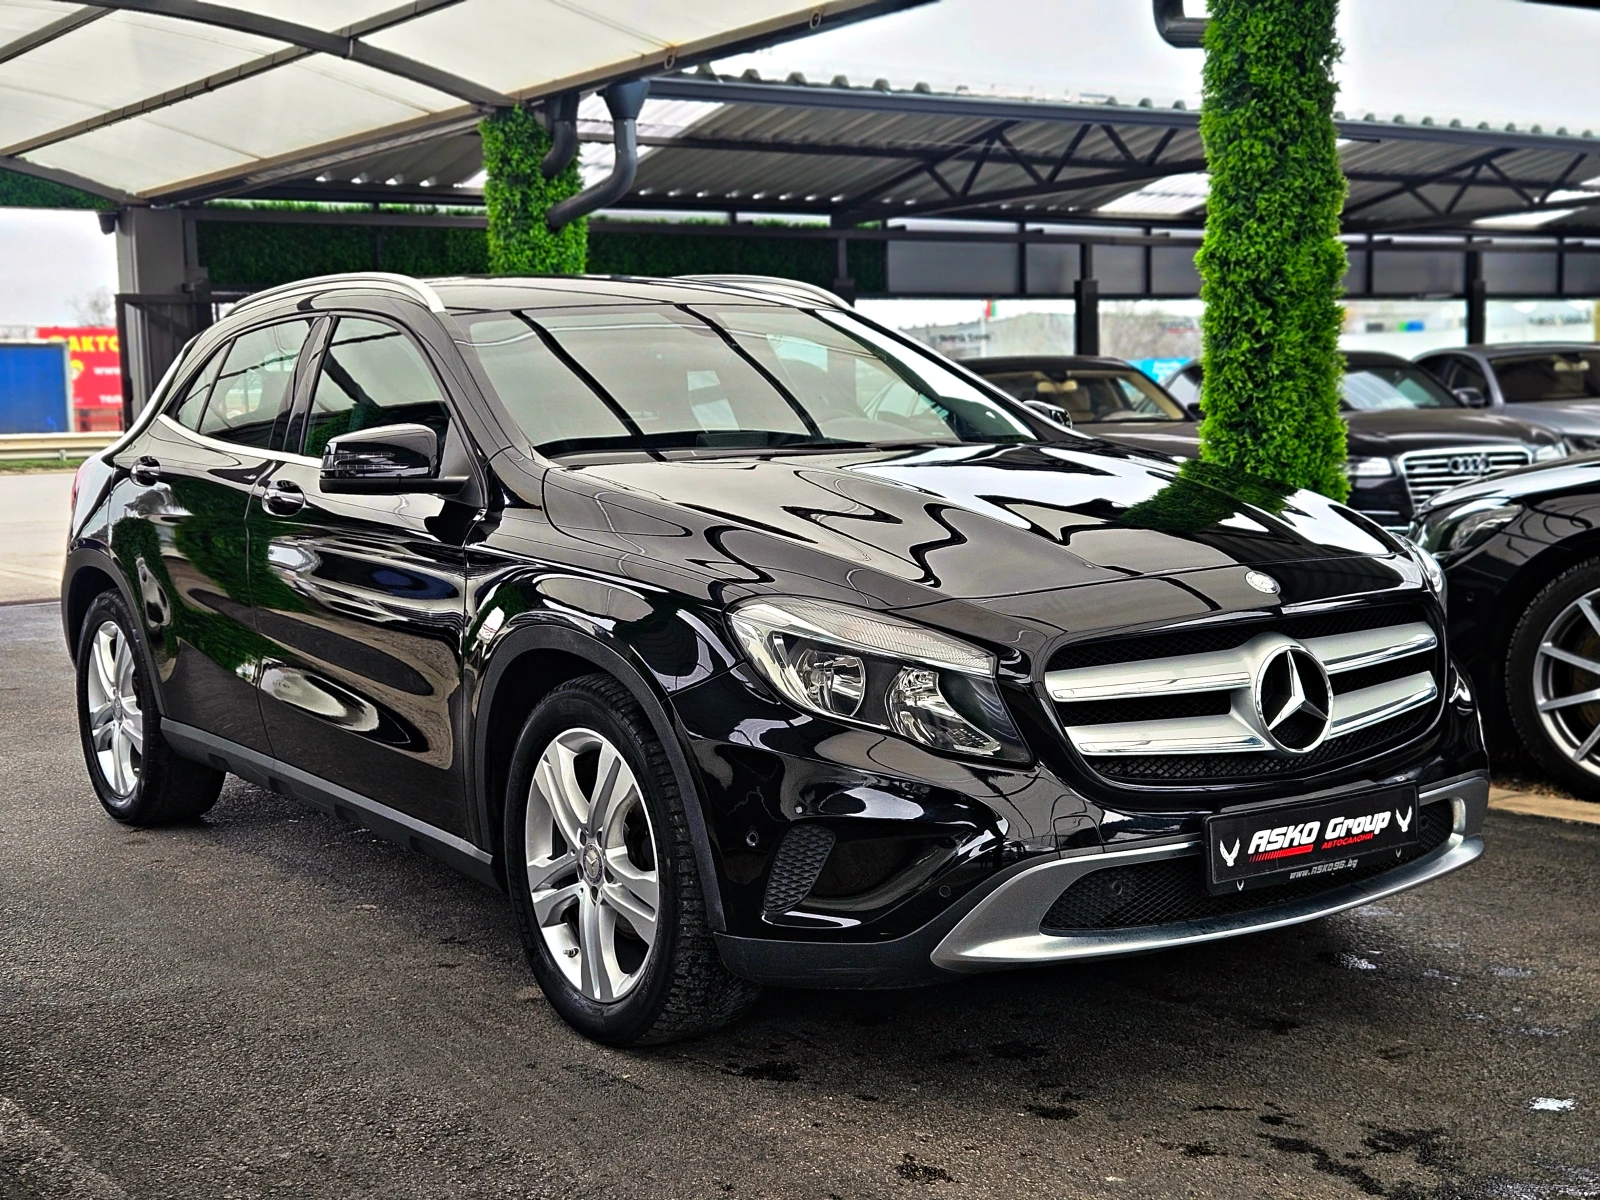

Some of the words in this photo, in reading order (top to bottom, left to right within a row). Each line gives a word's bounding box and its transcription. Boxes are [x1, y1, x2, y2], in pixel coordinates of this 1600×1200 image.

[1248, 821, 1321, 854] ASKO
[1325, 811, 1392, 840] Group
[1321, 832, 1374, 850] АВТОСАЛОНИ
